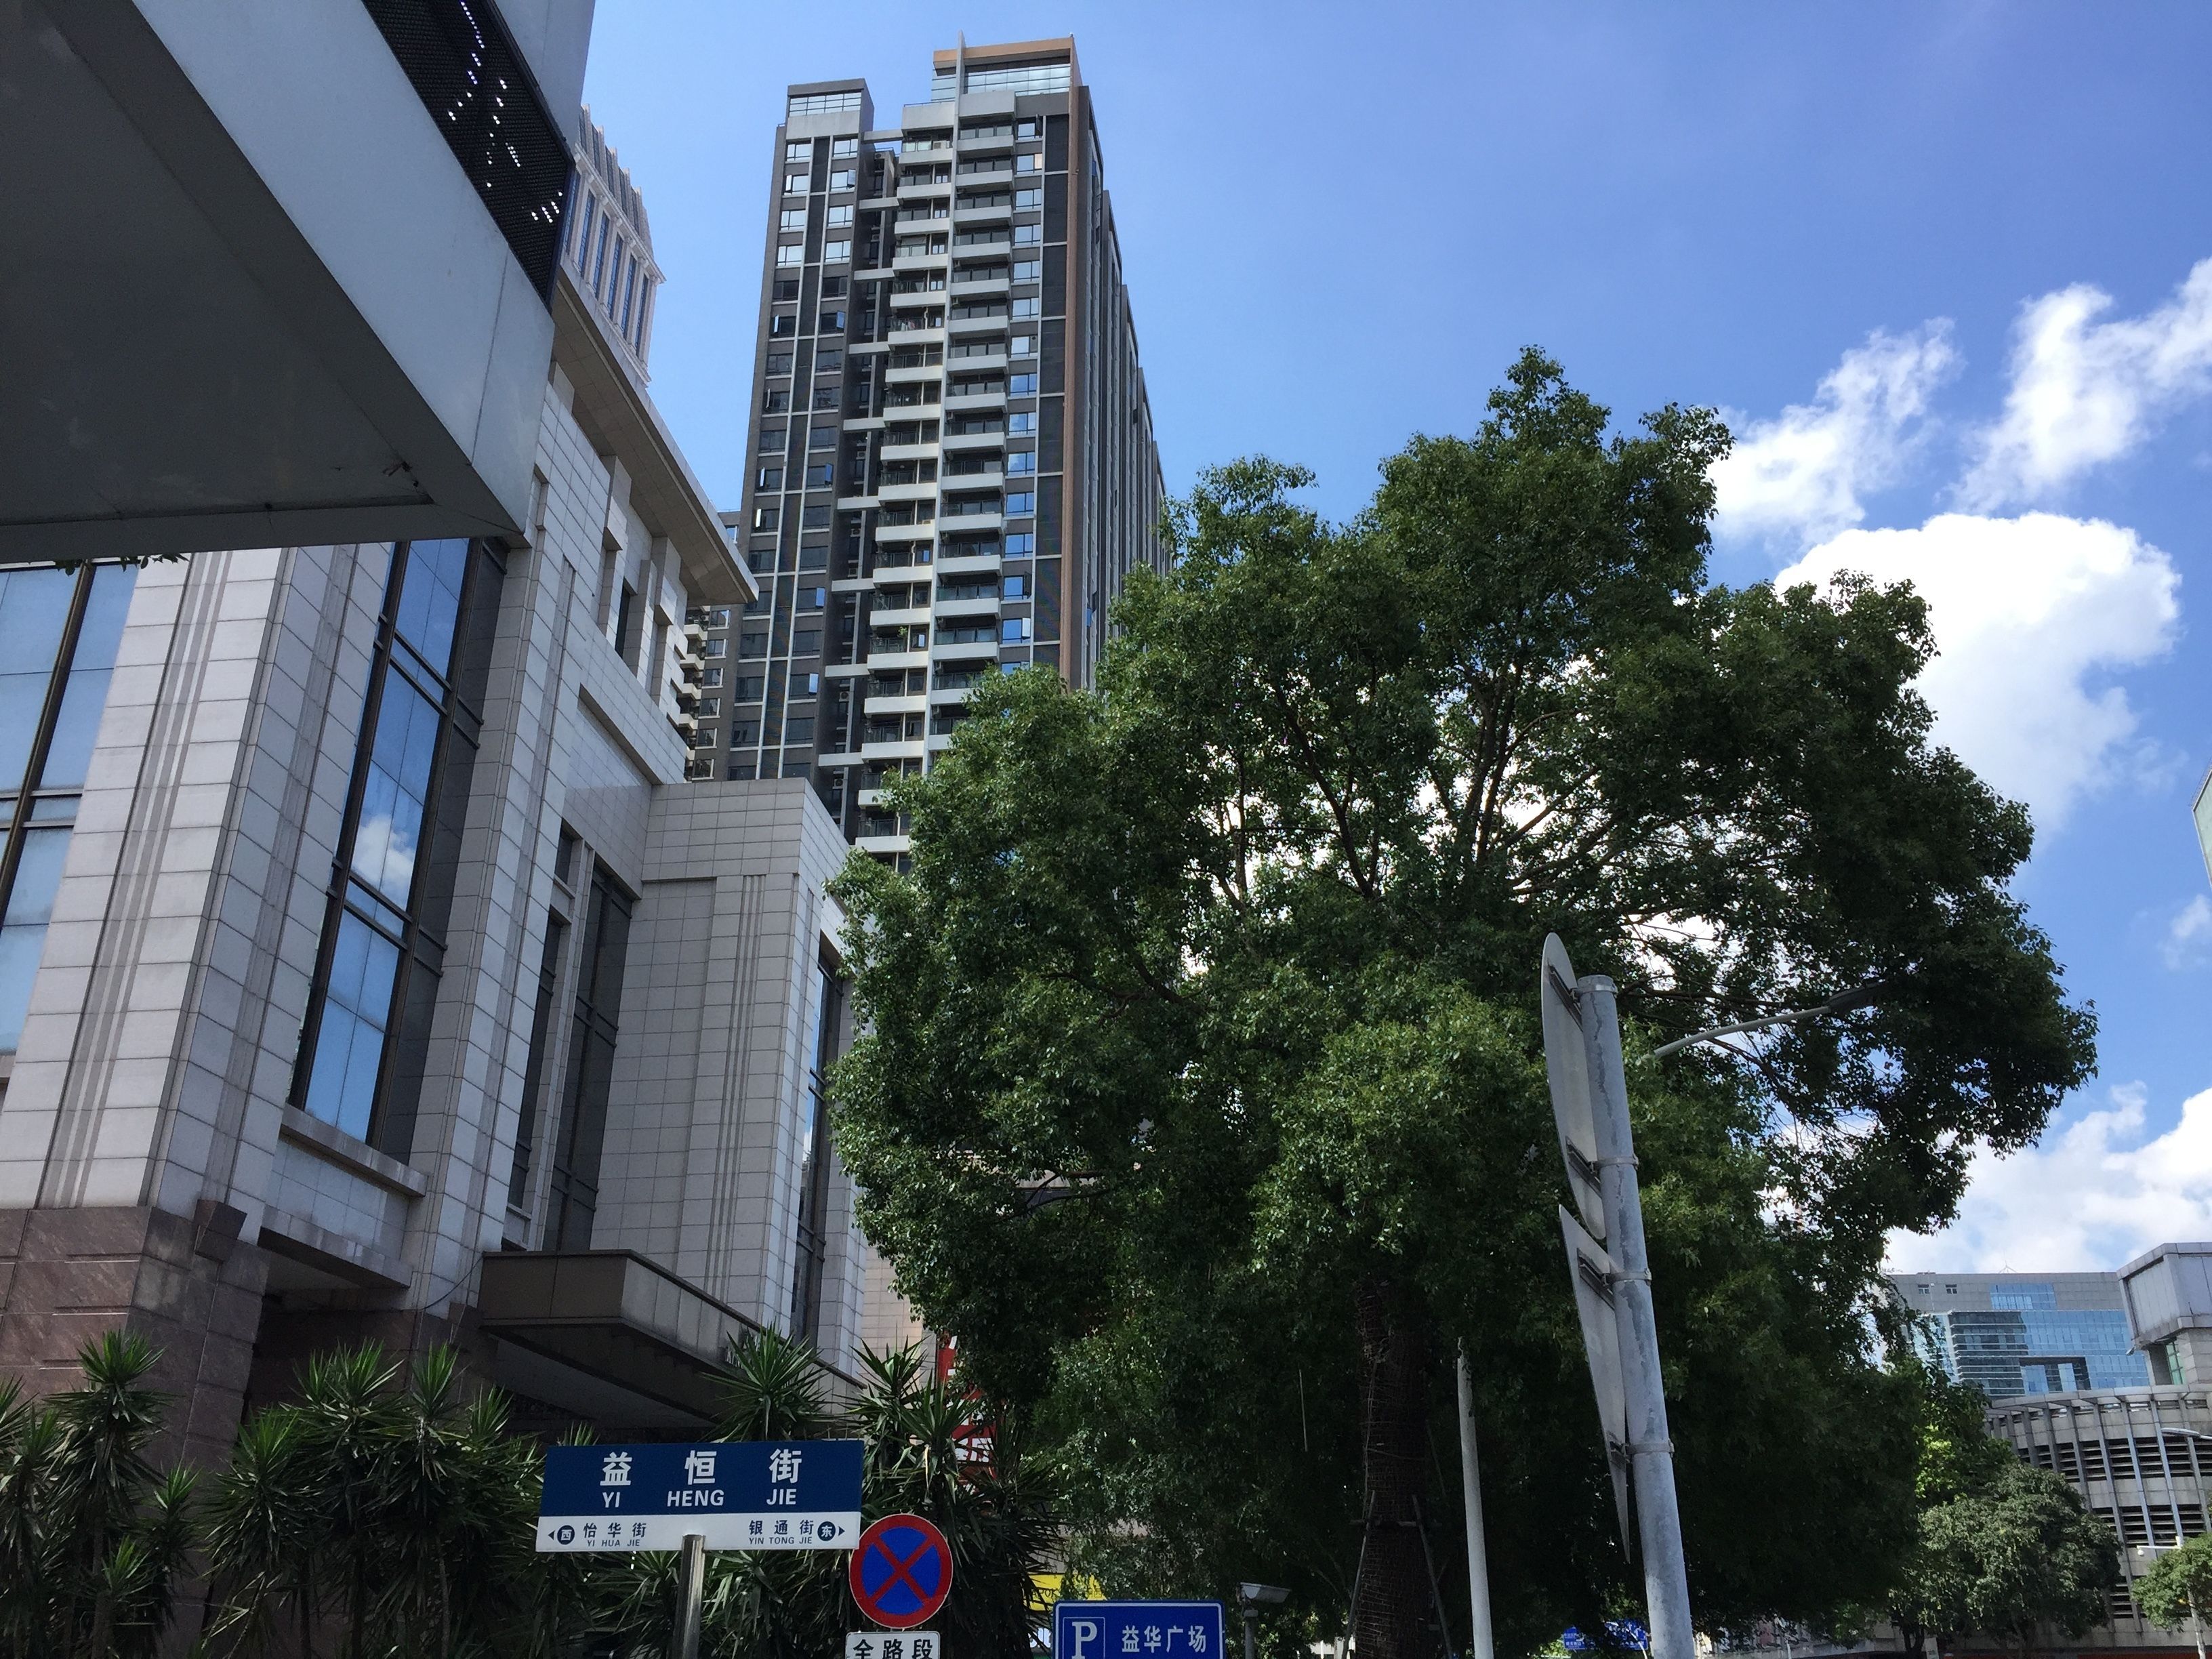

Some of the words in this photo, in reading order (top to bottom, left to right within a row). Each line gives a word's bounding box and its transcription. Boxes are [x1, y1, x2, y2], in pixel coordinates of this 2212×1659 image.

[600, 1448, 802, 1486] 益恒街
[602, 1492, 620, 1508] YI
[667, 1490, 724, 1507] HENG
[766, 1488, 796, 1506] JIE
[560, 1529, 572, 1540] 西
[583, 1522, 647, 1538] 怡华街
[749, 1519, 814, 1535] 银通街
[821, 1525, 832, 1537] 东
[587, 1539, 595, 1547] YI
[601, 1539, 620, 1547] HUA
[748, 1537, 764, 1545] YIN
[769, 1536, 794, 1544] TONG
[799, 1536, 812, 1544] JIE
[1071, 1621, 1098, 1659] P
[1122, 1625, 1206, 1653] 益华广场
[853, 1639, 933, 1659] 全路段
